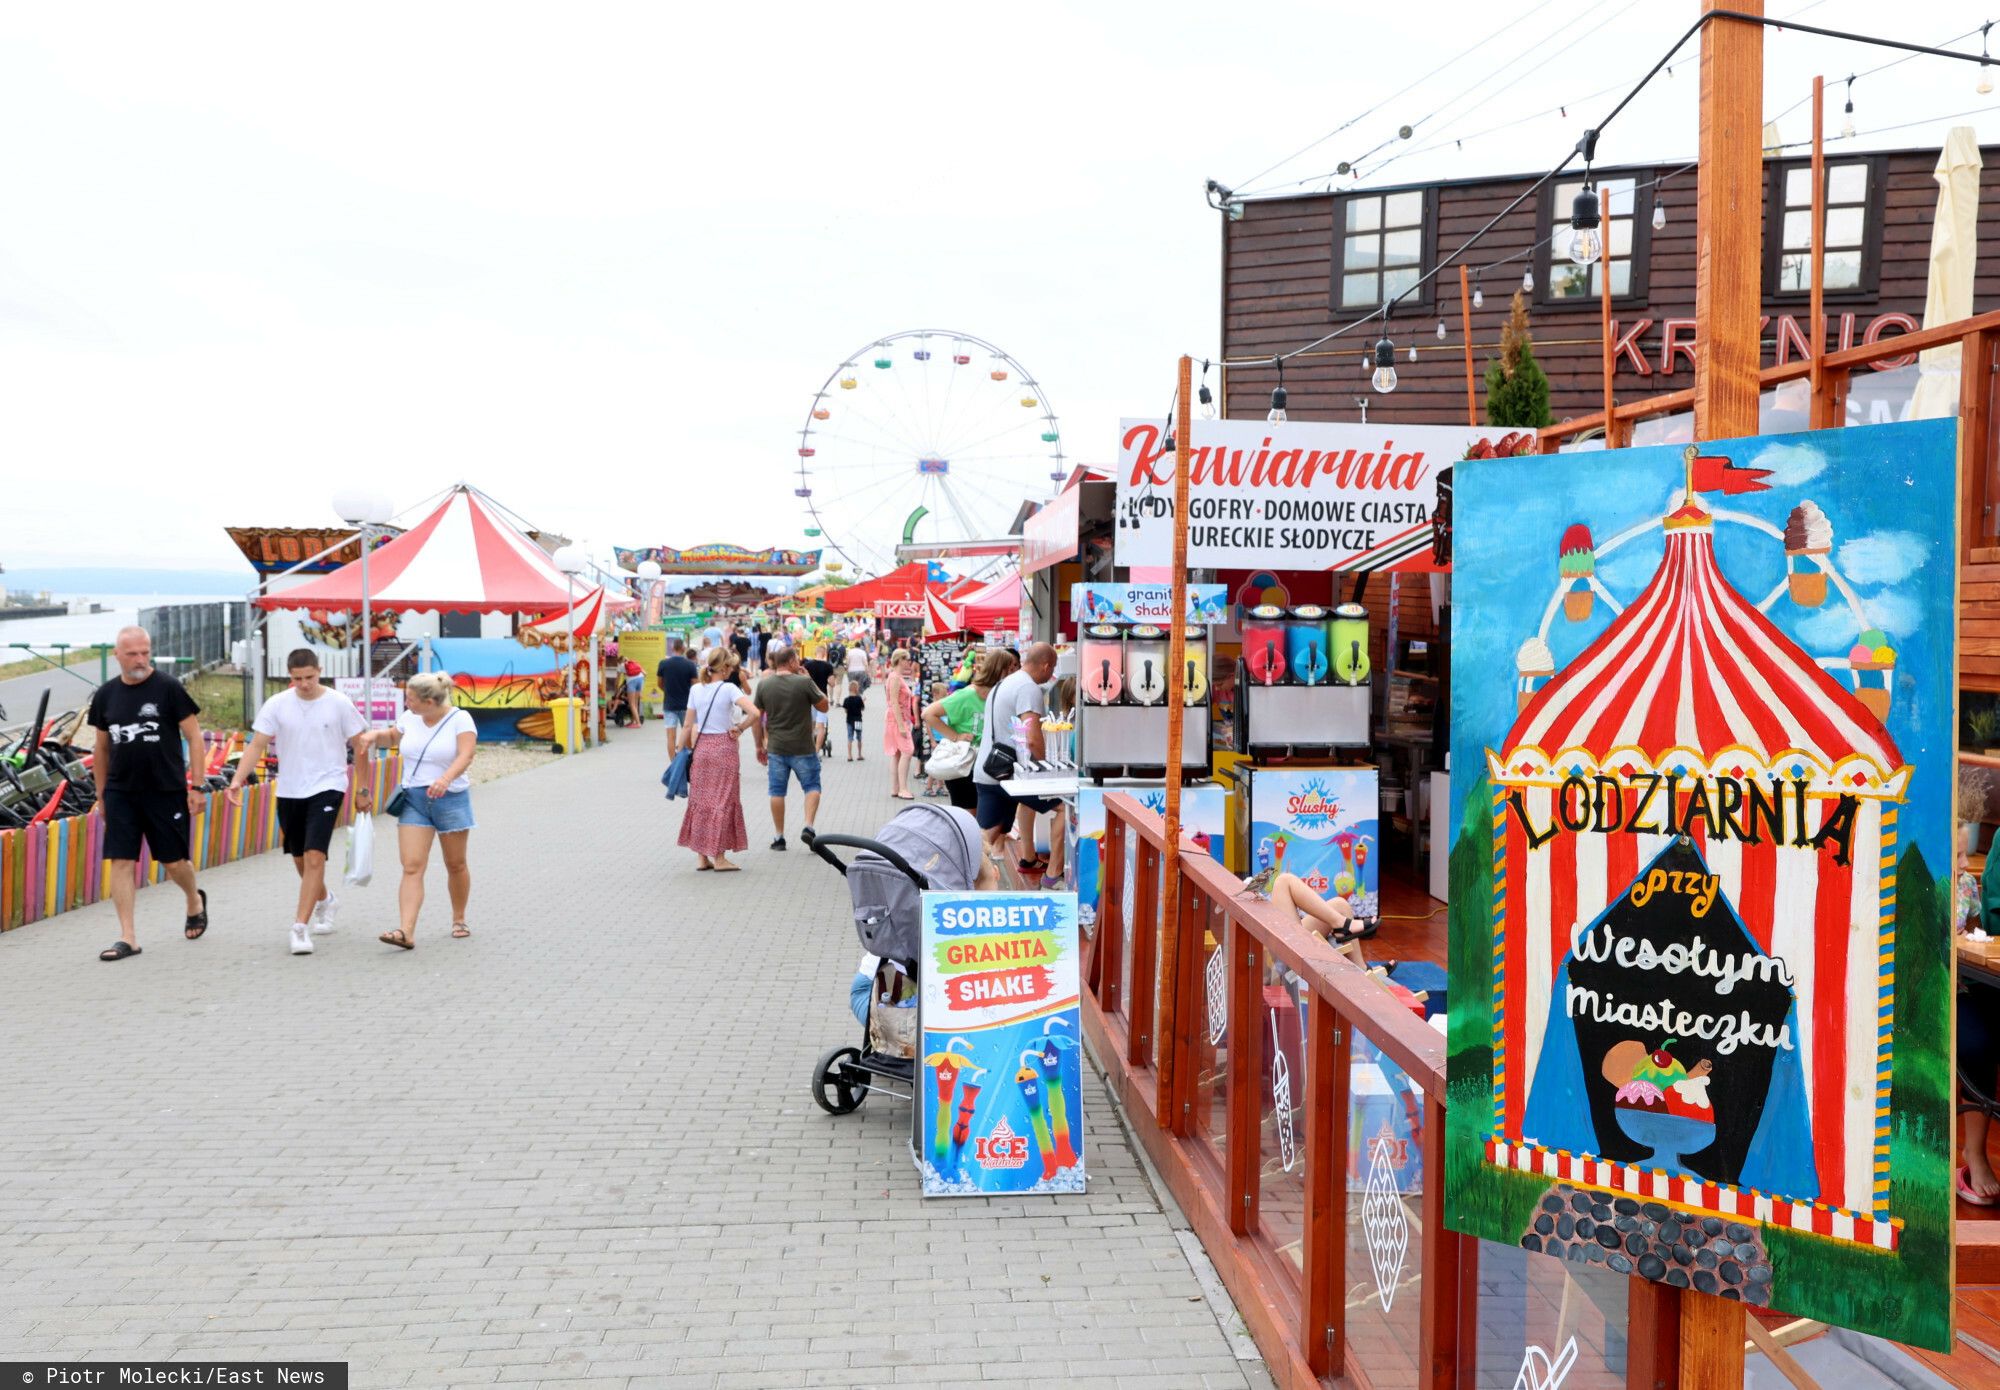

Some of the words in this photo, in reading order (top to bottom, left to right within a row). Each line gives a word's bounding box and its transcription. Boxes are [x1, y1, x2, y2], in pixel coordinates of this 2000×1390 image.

[1611, 312, 1921, 375] KRNIC
[1122, 424, 1429, 491] Kawiarnia
[1189, 498, 1254, 520] GOFRY
[1264, 499, 1355, 522] DOMOWE
[1361, 502, 1428, 524] CIASTA
[1188, 526, 1274, 548] URECKIE
[1280, 528, 1376, 550] SŁODYCZE
[1127, 588, 1172, 603] granit
[1287, 795, 1340, 819] Slushy
[1506, 773, 1862, 867] LODZIARNIA
[1630, 868, 1720, 918] przy
[942, 905, 1049, 929] SORBETY
[947, 938, 1047, 965] GRANITA
[1570, 922, 1795, 995] Wesołym
[960, 975, 1035, 1001] SHAKE
[976, 1137, 1026, 1158] ICE
